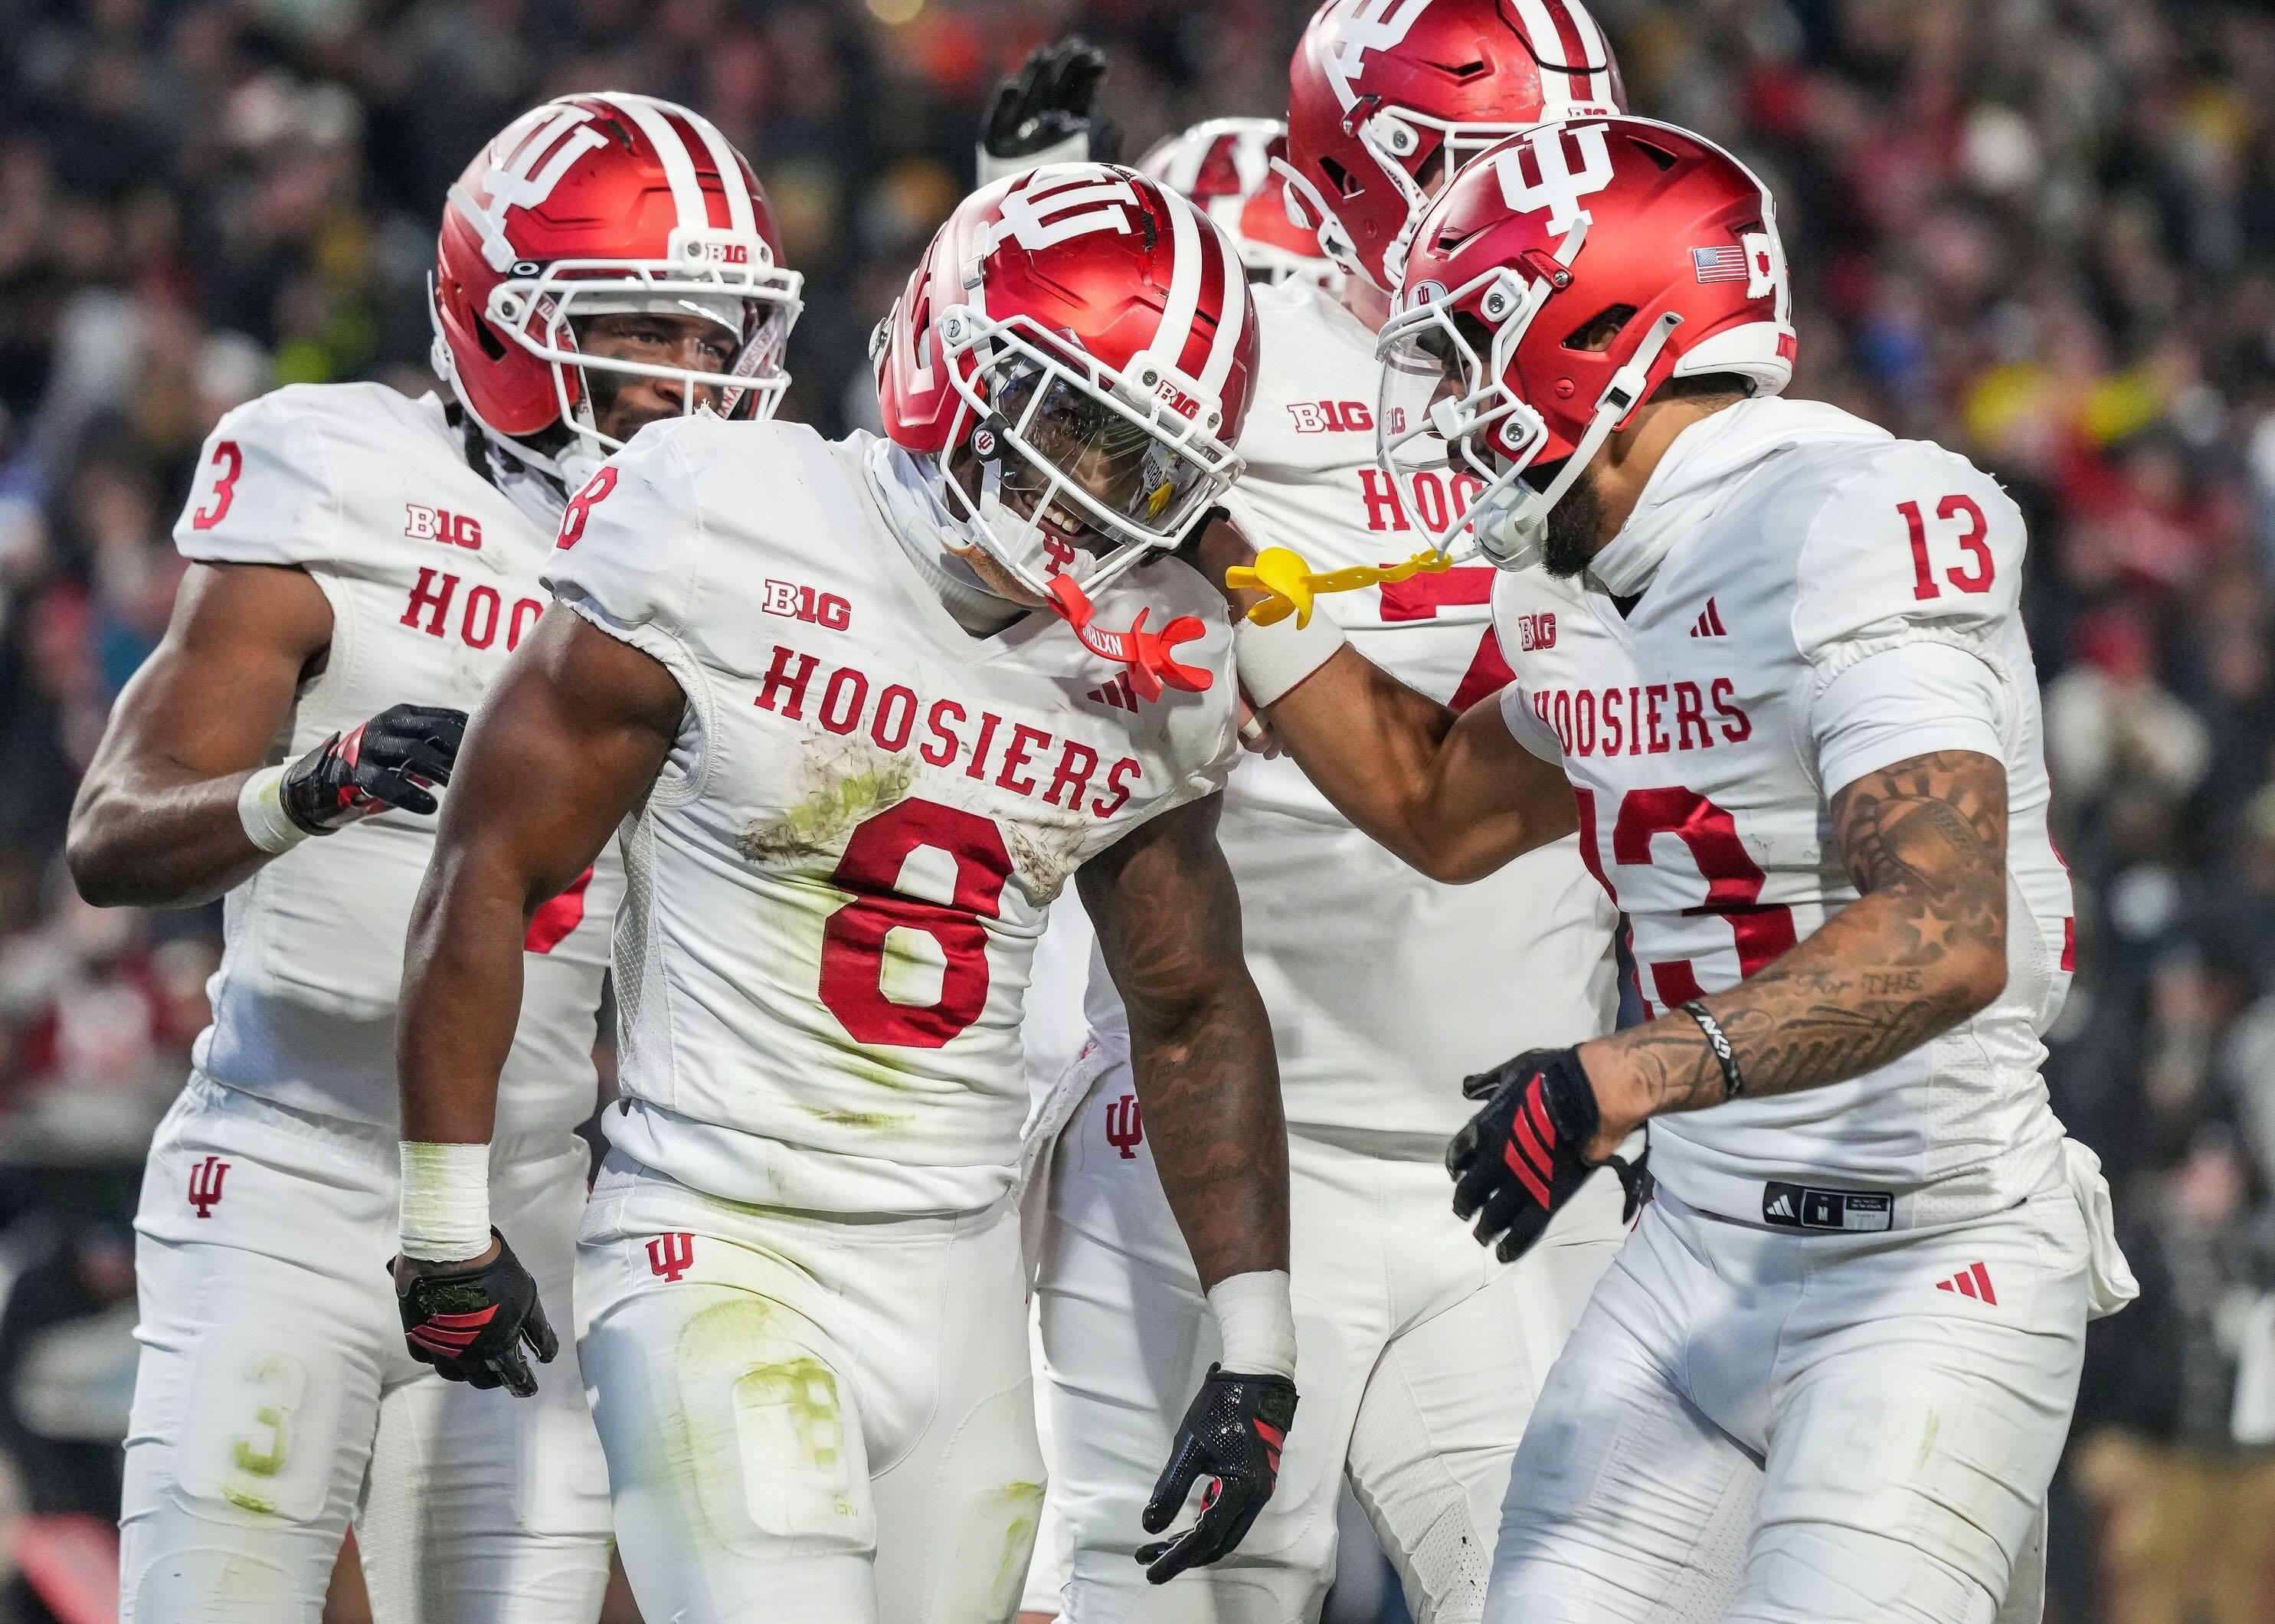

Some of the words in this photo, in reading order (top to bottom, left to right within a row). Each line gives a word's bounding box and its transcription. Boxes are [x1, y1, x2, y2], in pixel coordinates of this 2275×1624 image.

[192, 440, 243, 531] 3
[556, 466, 619, 551] 8
[1896, 493, 1998, 602] 13
[753, 645, 1142, 819] HOOSIERS
[818, 796, 1015, 1049] 8
